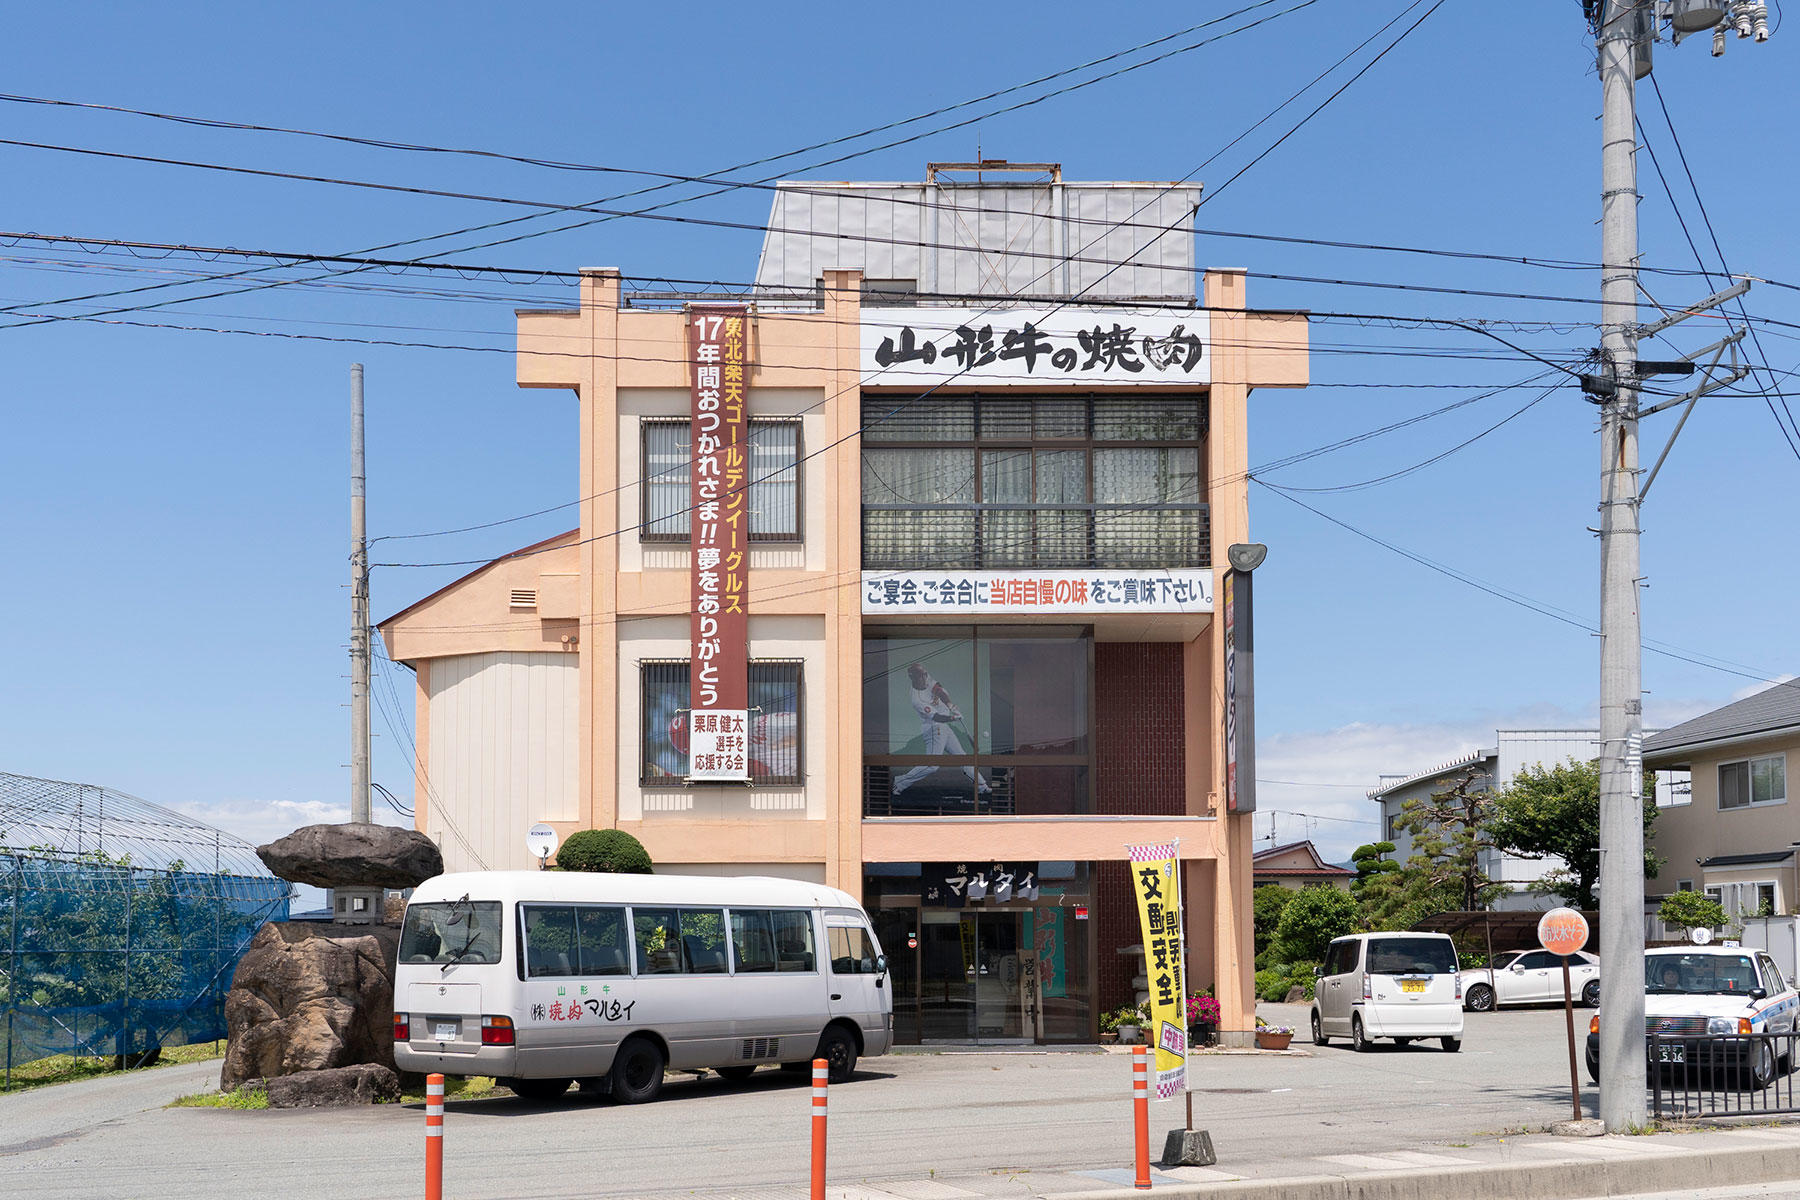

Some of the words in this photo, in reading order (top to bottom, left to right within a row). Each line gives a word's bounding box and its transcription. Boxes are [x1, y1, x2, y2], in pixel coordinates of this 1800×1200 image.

[875, 321, 1203, 374] 山形牛の焼肉
[724, 317, 744, 614] 東北楽天ゴールデンイーグルス
[716, 736, 744, 752] 選手を
[695, 754, 744, 770] 応援する会
[945, 872, 1034, 896] マルタイ
[1543, 923, 1584, 942] 防火水そう
